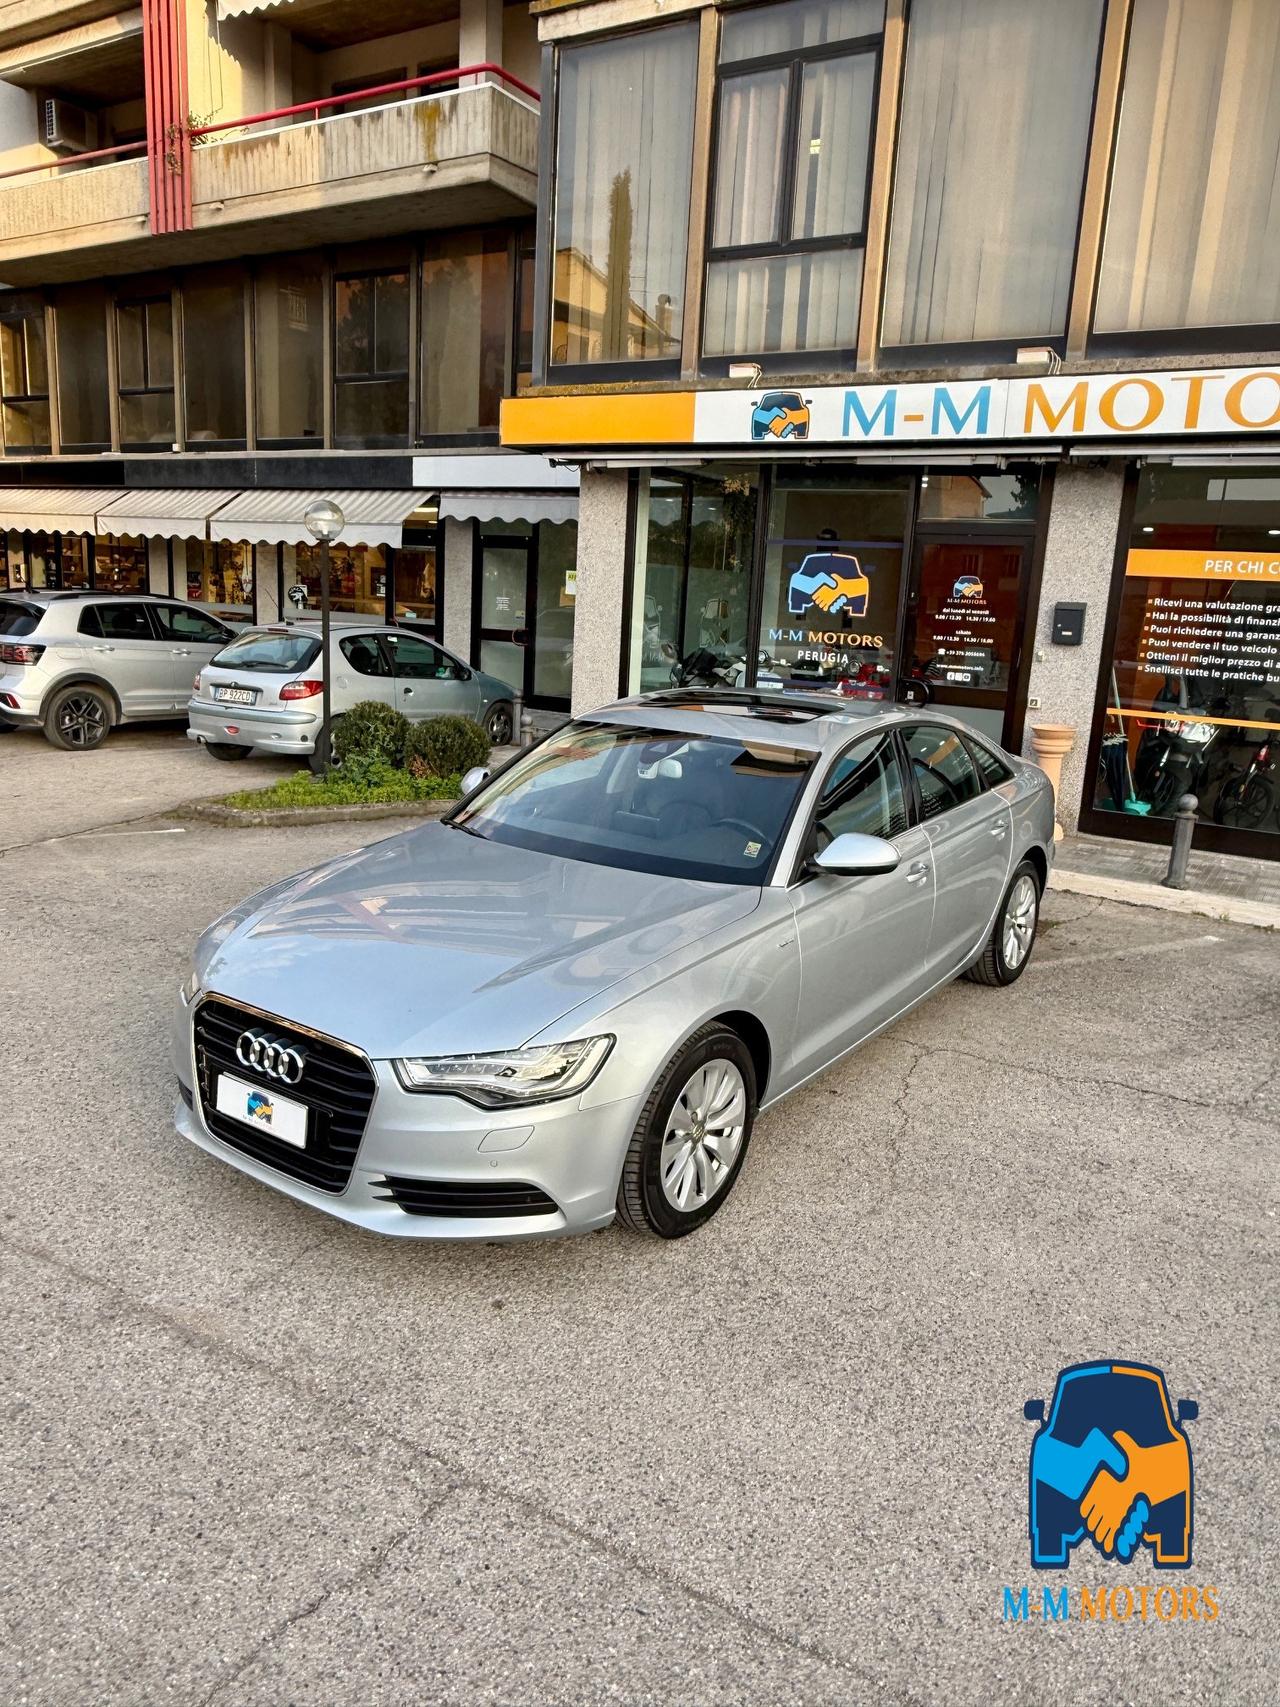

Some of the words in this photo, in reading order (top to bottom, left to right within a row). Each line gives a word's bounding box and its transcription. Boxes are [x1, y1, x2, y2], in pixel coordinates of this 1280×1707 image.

[842, 386, 991, 437] M-M
[1204, 560, 1233, 574] PER
[1237, 560, 1264, 574] CHI
[1268, 561, 1280, 576] C
[1154, 598, 1183, 608] Ricevi
[1184, 600, 1203, 609] una
[1205, 600, 1264, 612] valutazione
[1152, 611, 1169, 620] Hai
[1170, 612, 1179, 621] la
[1181, 613, 1232, 624] possibilità
[1234, 615, 1245, 625] di
[769, 629, 803, 642] M-M
[807, 630, 884, 648] MOTORS
[1150, 624, 1172, 634] Puoi
[1173, 625, 1223, 637] richiedere
[1225, 630, 1244, 638] una
[1148, 638, 1170, 648] Puoi
[1171, 640, 1211, 650] vendere
[1212, 642, 1220, 651] il
[1221, 643, 1239, 652] tuo
[1240, 644, 1278, 654] veicolo
[797, 650, 849, 664] PERUGIA
[1146, 651, 1180, 661] Ottieni
[1181, 653, 1189, 662] il
[1190, 655, 1226, 666] miglior
[1227, 658, 1261, 667] prezzo
[1263, 659, 1274, 668] di
[1144, 664, 1184, 675] Snellisci
[1185, 667, 1210, 677] tutte
[1211, 669, 1220, 678] le
[1222, 671, 1265, 681] pratiche
